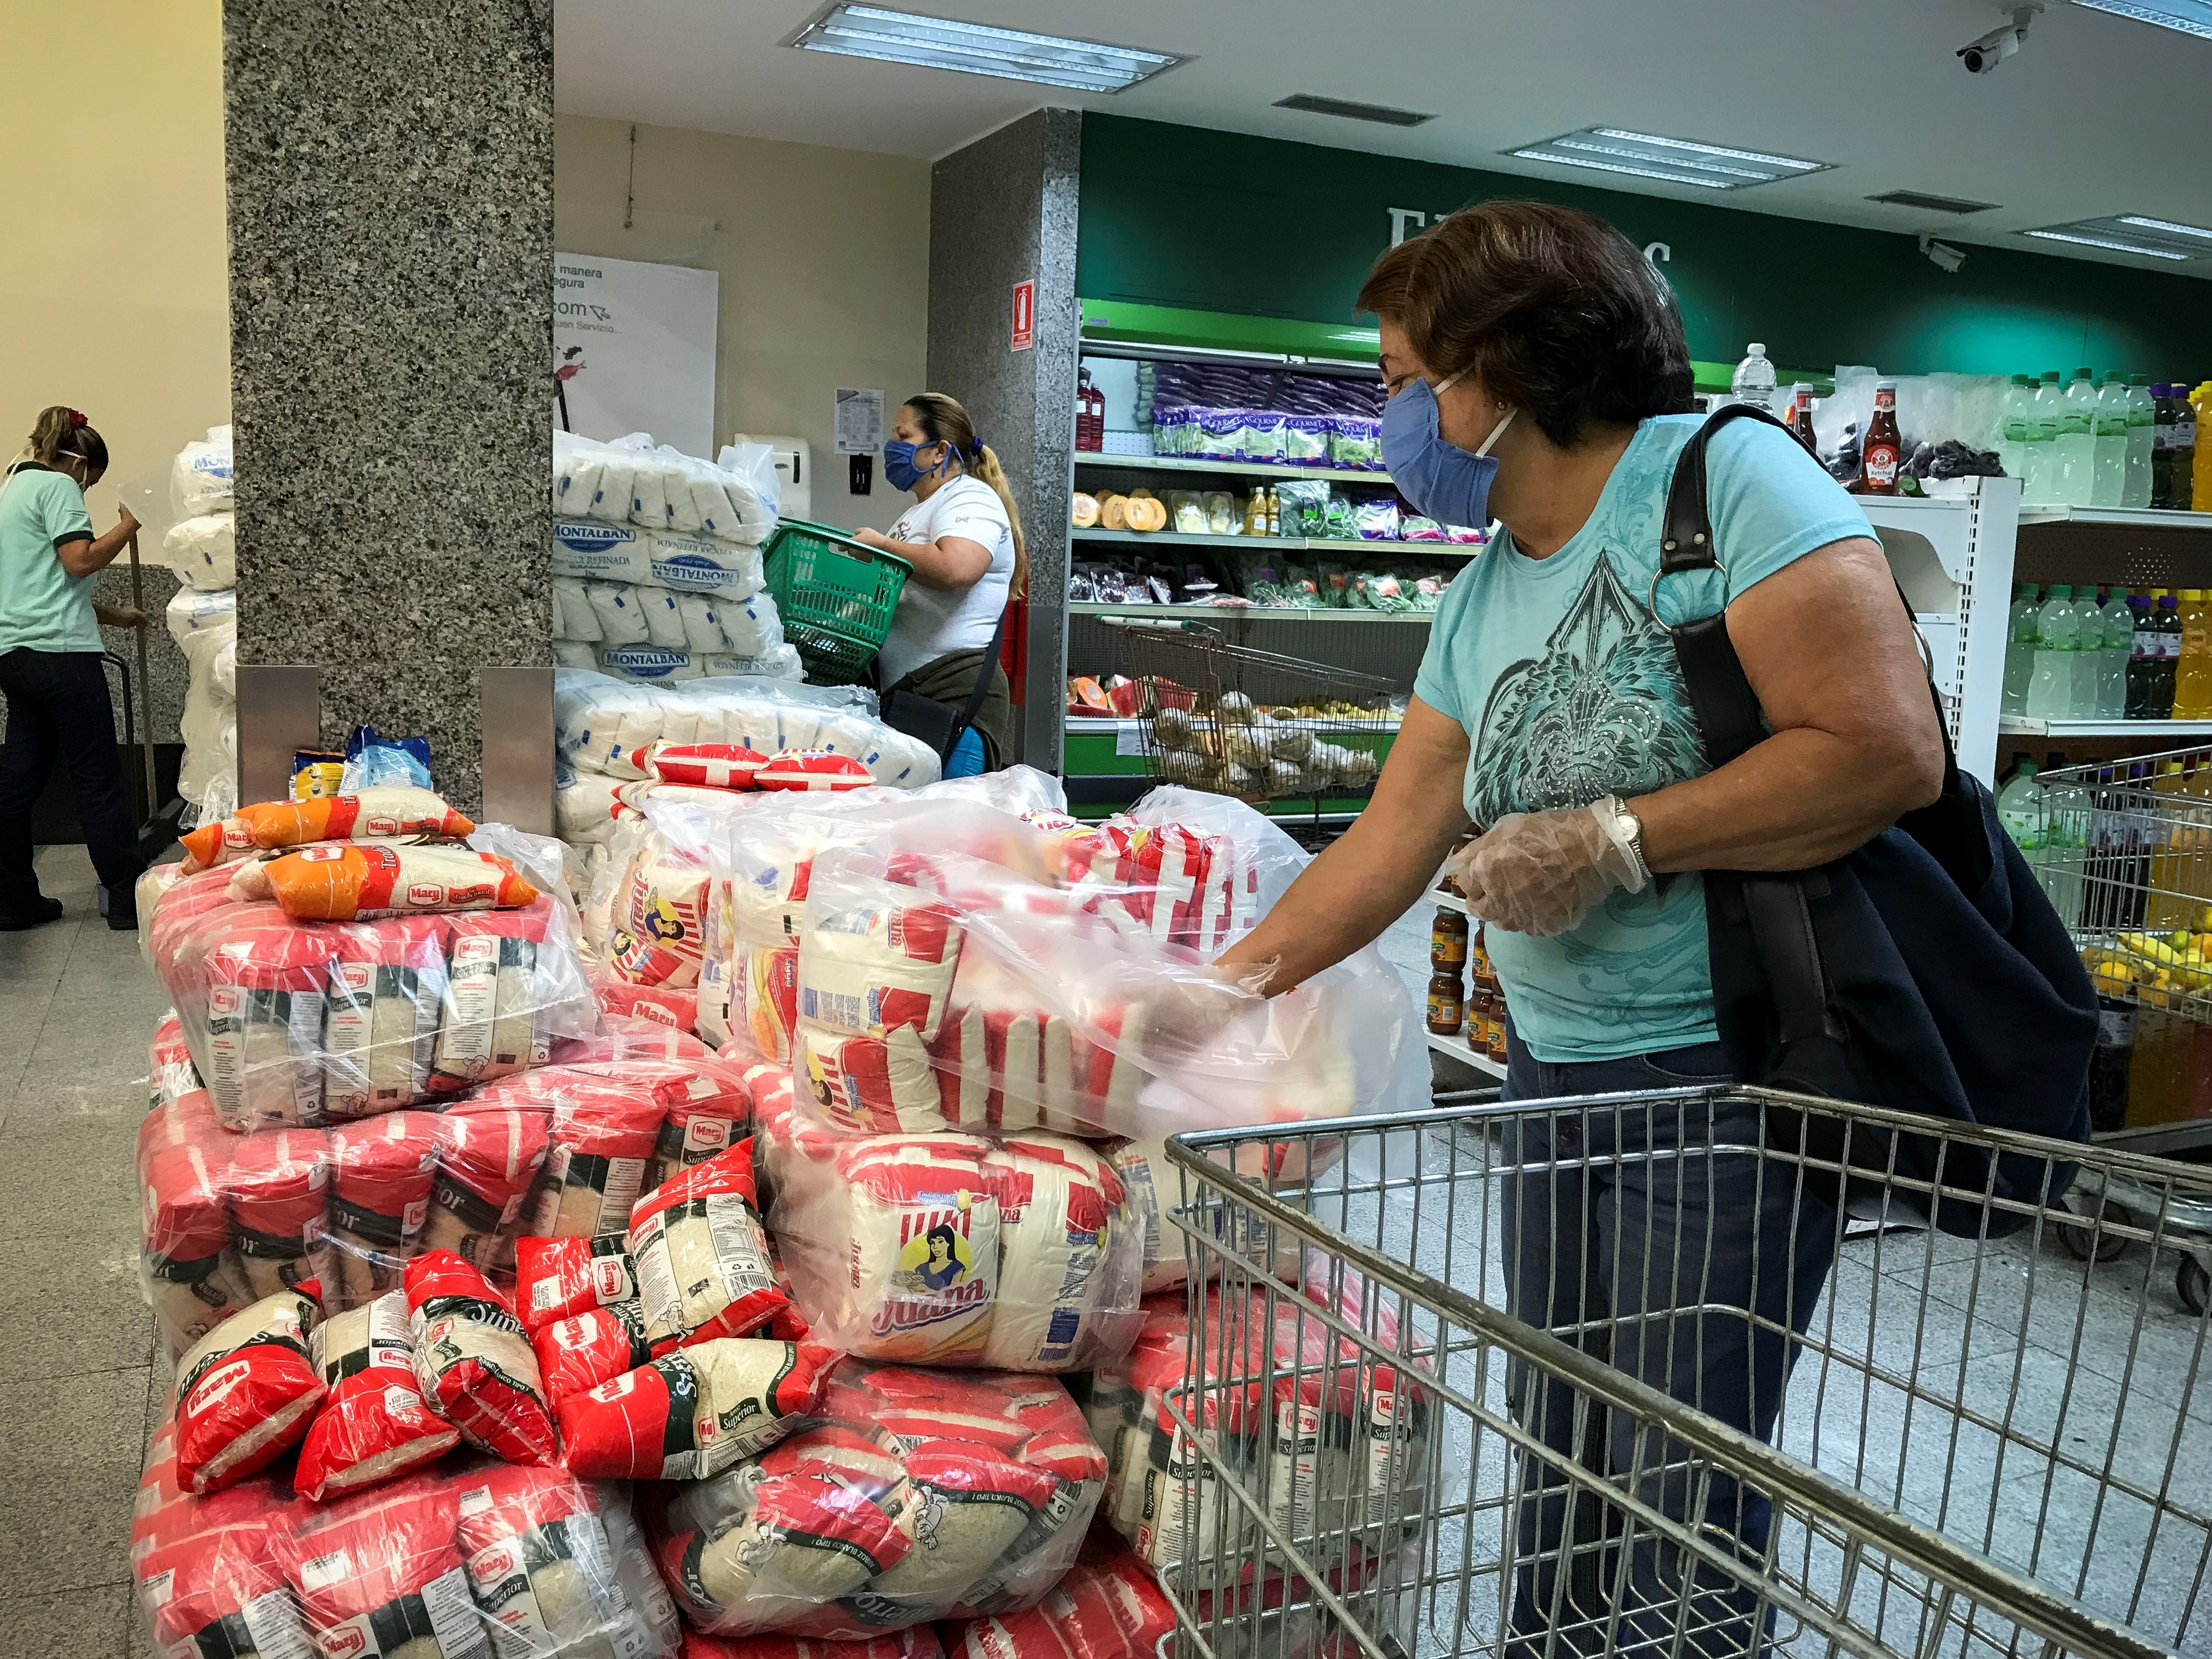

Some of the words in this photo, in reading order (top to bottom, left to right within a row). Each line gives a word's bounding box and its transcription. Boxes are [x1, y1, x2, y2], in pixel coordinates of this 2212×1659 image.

[560, 265, 603, 278] manera
[552, 277, 585, 289] egura
[606, 653, 686, 665] MONTALBAN
[369, 822, 394, 833] Mary
[410, 888, 441, 899] Mary
[633, 868, 649, 937] Juan
[696, 1126, 722, 1141] Mary
[603, 1262, 617, 1294] Mary
[872, 1277, 988, 1332] Juana
[189, 1364, 249, 1411] Mary
[512, 1379, 526, 1391] TIPO
[723, 1403, 756, 1430] Superior
[992, 1494, 1014, 1504] BLANCO
[1145, 1473, 1154, 1517] Superior
[1013, 1498, 1030, 1513] ARROZ
[816, 1539, 832, 1548] TIPO
[832, 1541, 859, 1557] BLANCO
[474, 1553, 508, 1575] Mary
[858, 1550, 876, 1568] ARROZ
